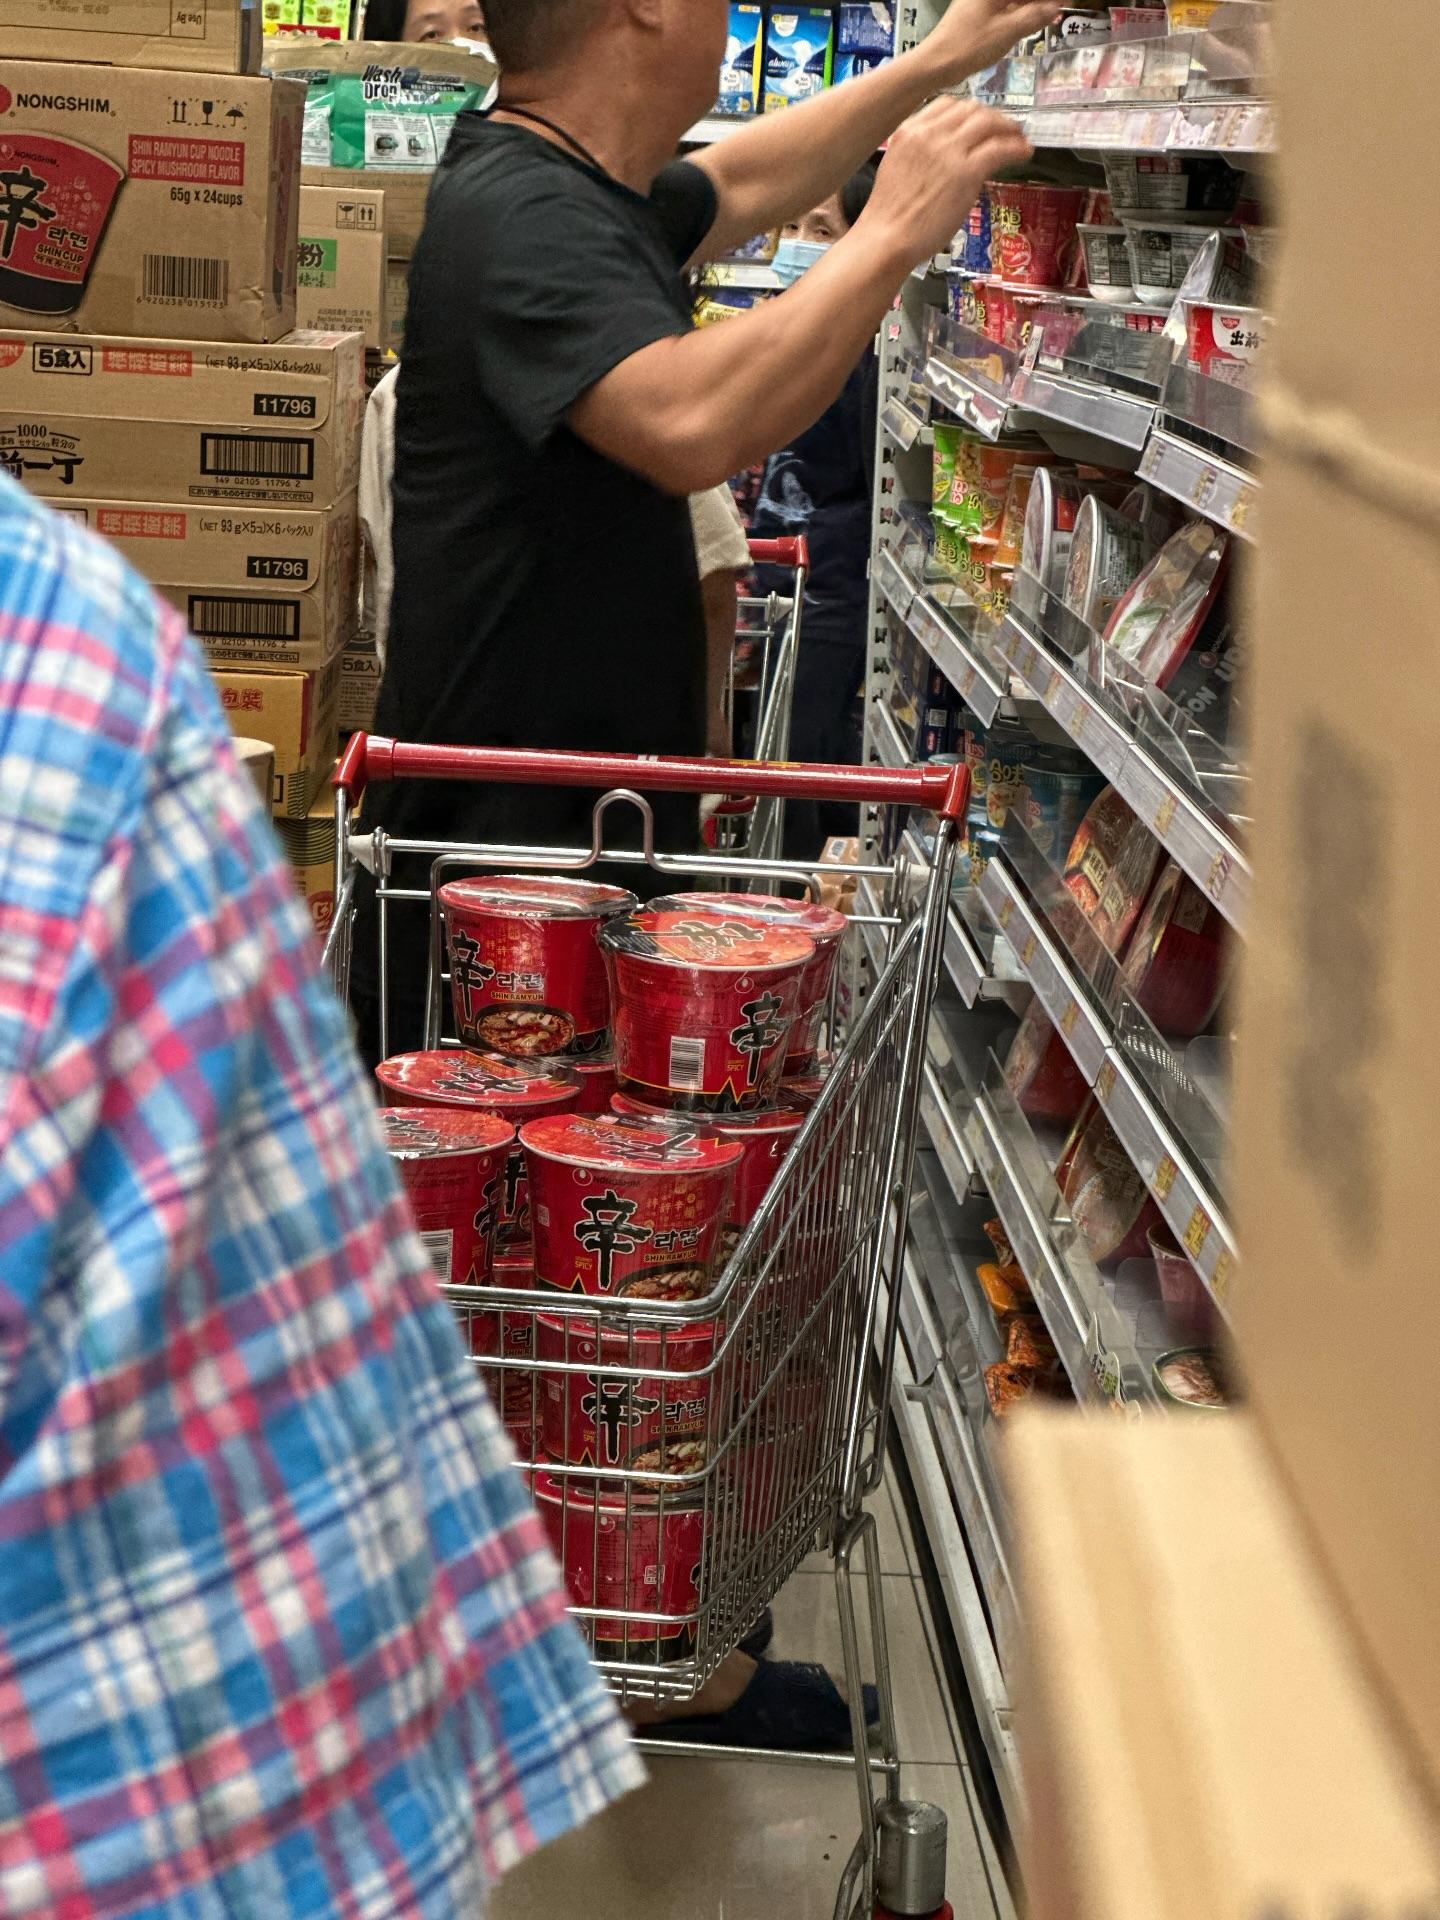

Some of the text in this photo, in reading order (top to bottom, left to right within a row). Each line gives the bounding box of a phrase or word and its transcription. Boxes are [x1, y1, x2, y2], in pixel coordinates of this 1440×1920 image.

[176, 12, 202, 26] Use By
[362, 65, 402, 83] Wash
[16, 93, 110, 113] NONGSHIM
[132, 140, 240, 162] SHIN RAMYUN CUP NOODLE
[132, 158, 240, 180] SPICY MUSHROOM FLAVOR
[170, 187, 190, 205] 65g
[203, 189, 243, 208] 24cups
[46, 225, 88, 251] 라면
[38, 348, 87, 370] 5食入
[259, 398, 312, 416] 11796
[16, 424, 47, 438] 1000
[234, 476, 260, 486] 02105
[266, 478, 290, 488] 11796
[252, 559, 304, 577] 11796
[222, 638, 247, 647] 02105
[252, 640, 278, 648] 11796
[342, 657, 376, 673] 5食入
[450, 928, 496, 1022] 辛
[496, 972, 545, 992] 라면
[491, 992, 510, 1000] SHIN
[730, 990, 786, 1086] 辛
[574, 1188, 654, 1291] 辛
[654, 1226, 700, 1251] 라면
[574, 1261, 593, 1270] SPICY
[644, 1253, 666, 1262] SHIN
[664, 1398, 706, 1424] 라면
